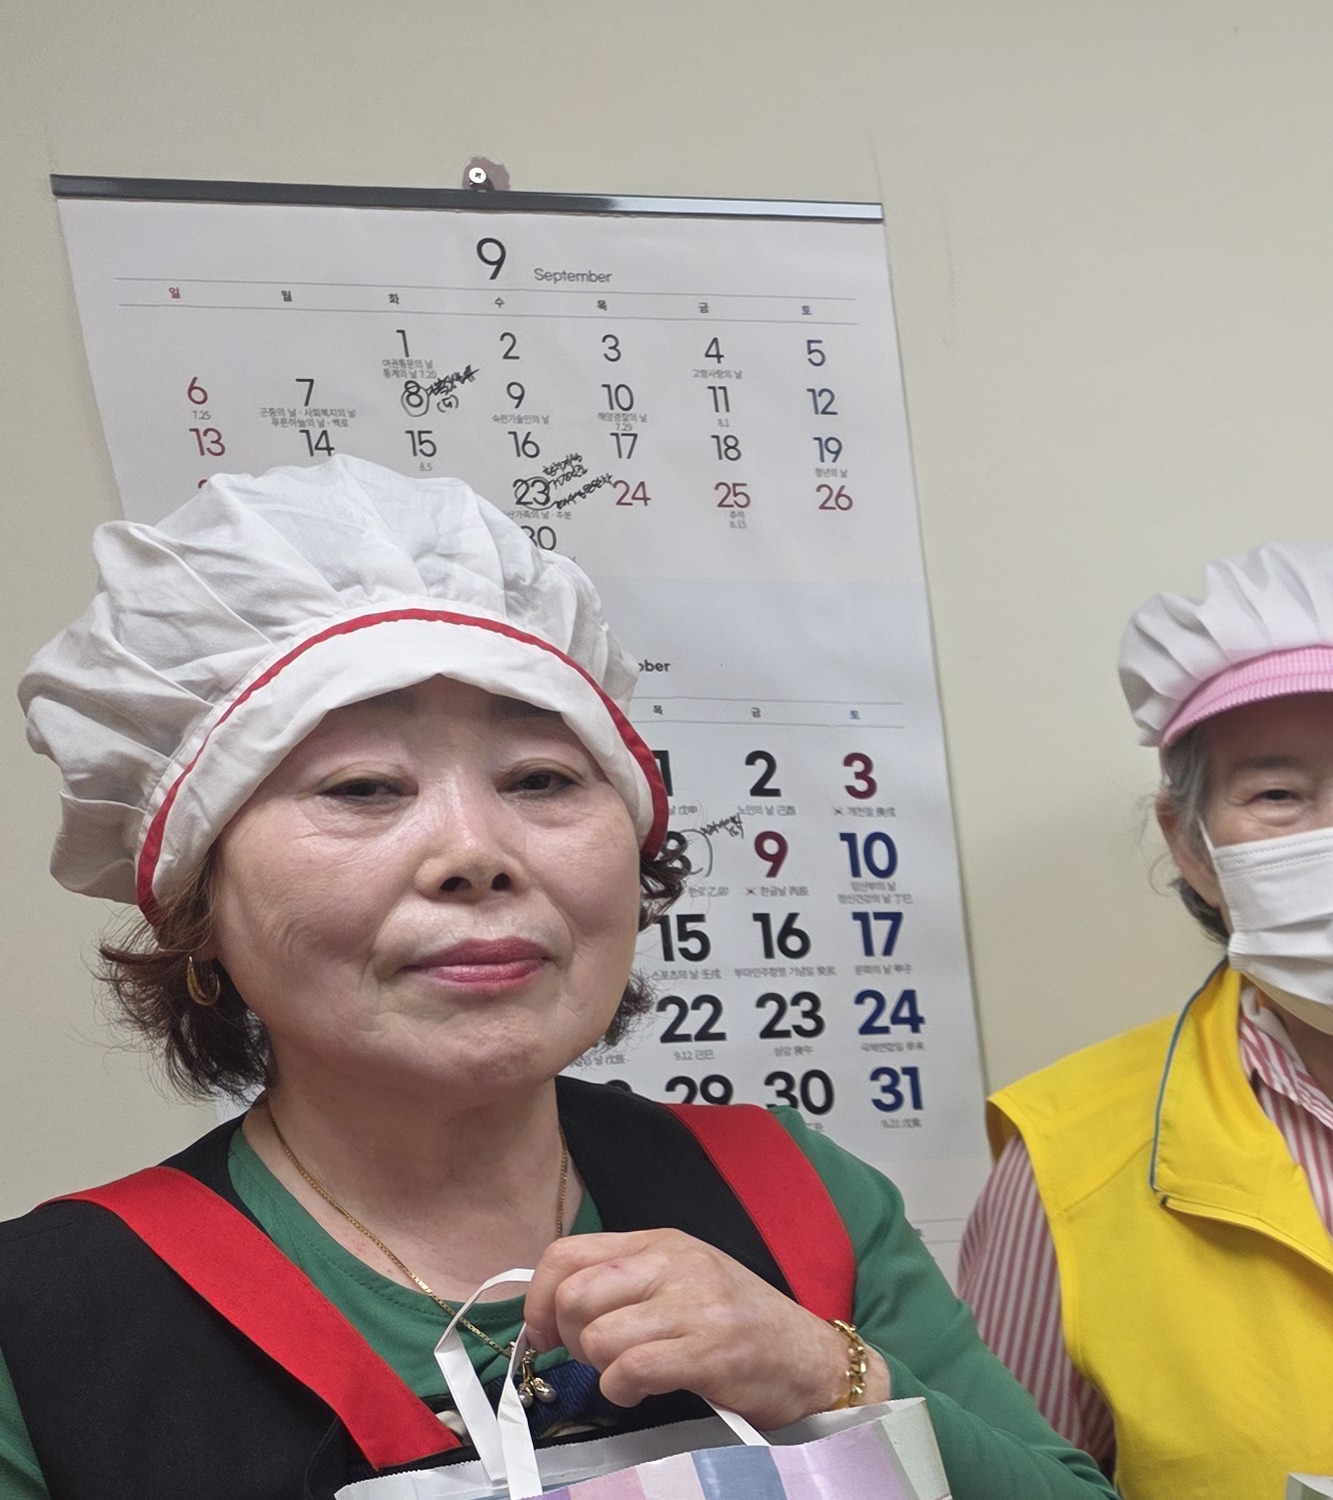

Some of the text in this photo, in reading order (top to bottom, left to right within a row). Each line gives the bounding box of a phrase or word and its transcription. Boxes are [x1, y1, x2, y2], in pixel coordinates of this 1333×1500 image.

[477, 238, 612, 284] 9 September
[168, 287, 181, 299] 일
[396, 330, 825, 366] 1 2 3 4 5
[187, 377, 208, 405] 6
[296, 379, 314, 406] 7
[403, 379, 425, 409] 8
[507, 382, 525, 409] 9
[601, 383, 634, 411] 10
[707, 386, 729, 413] 11
[807, 388, 838, 415] 12
[189, 428, 842, 463] 13 14 15 16 17 18 19
[512, 478, 550, 507] 23
[611, 480, 651, 506] 24
[714, 482, 750, 508] 25
[816, 484, 853, 511] 26
[745, 750, 781, 797] 2
[843, 753, 877, 799] 3
[754, 831, 788, 878] 9
[839, 832, 897, 879] 10
[653, 912, 903, 962] 15 16 17
[656, 989, 925, 1043] 22 23 24
[665, 1067, 923, 1118] 29 30 31
